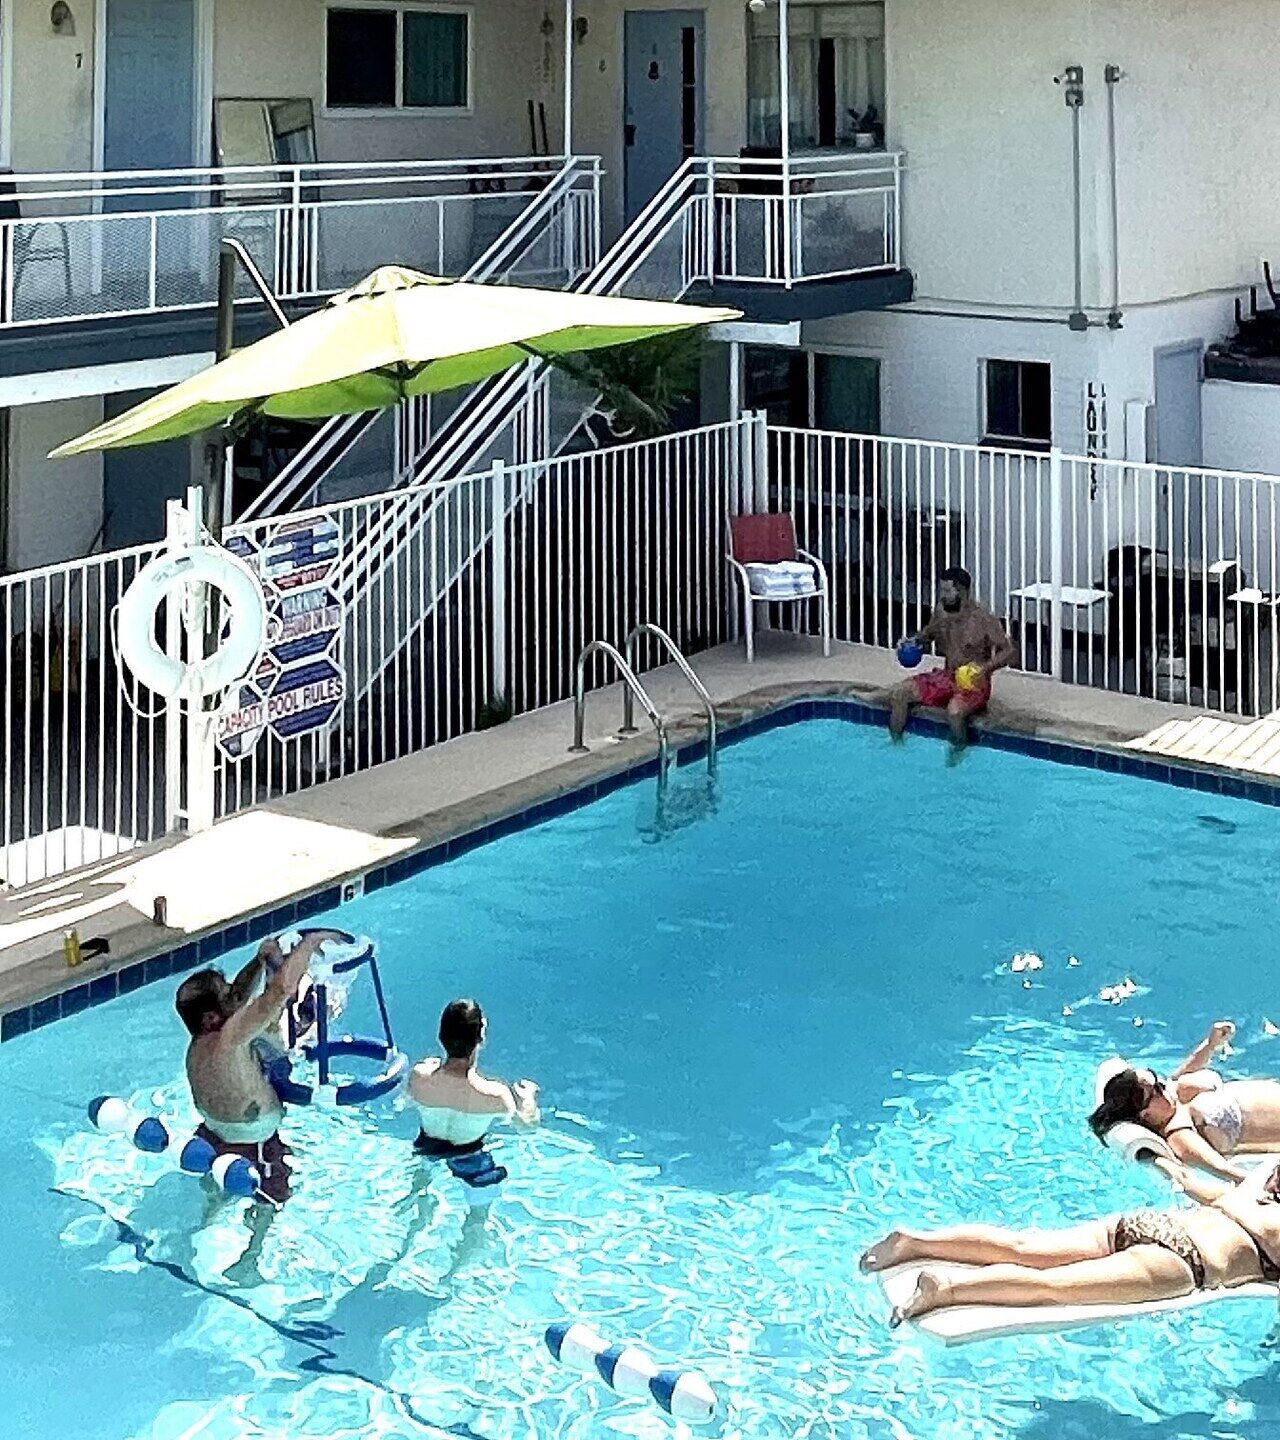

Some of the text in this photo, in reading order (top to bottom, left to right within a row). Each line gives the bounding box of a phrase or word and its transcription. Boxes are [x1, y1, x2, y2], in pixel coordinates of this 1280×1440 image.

[75, 52, 83, 68] 7
[267, 692, 299, 719] POOL
[303, 676, 344, 707] RULES
